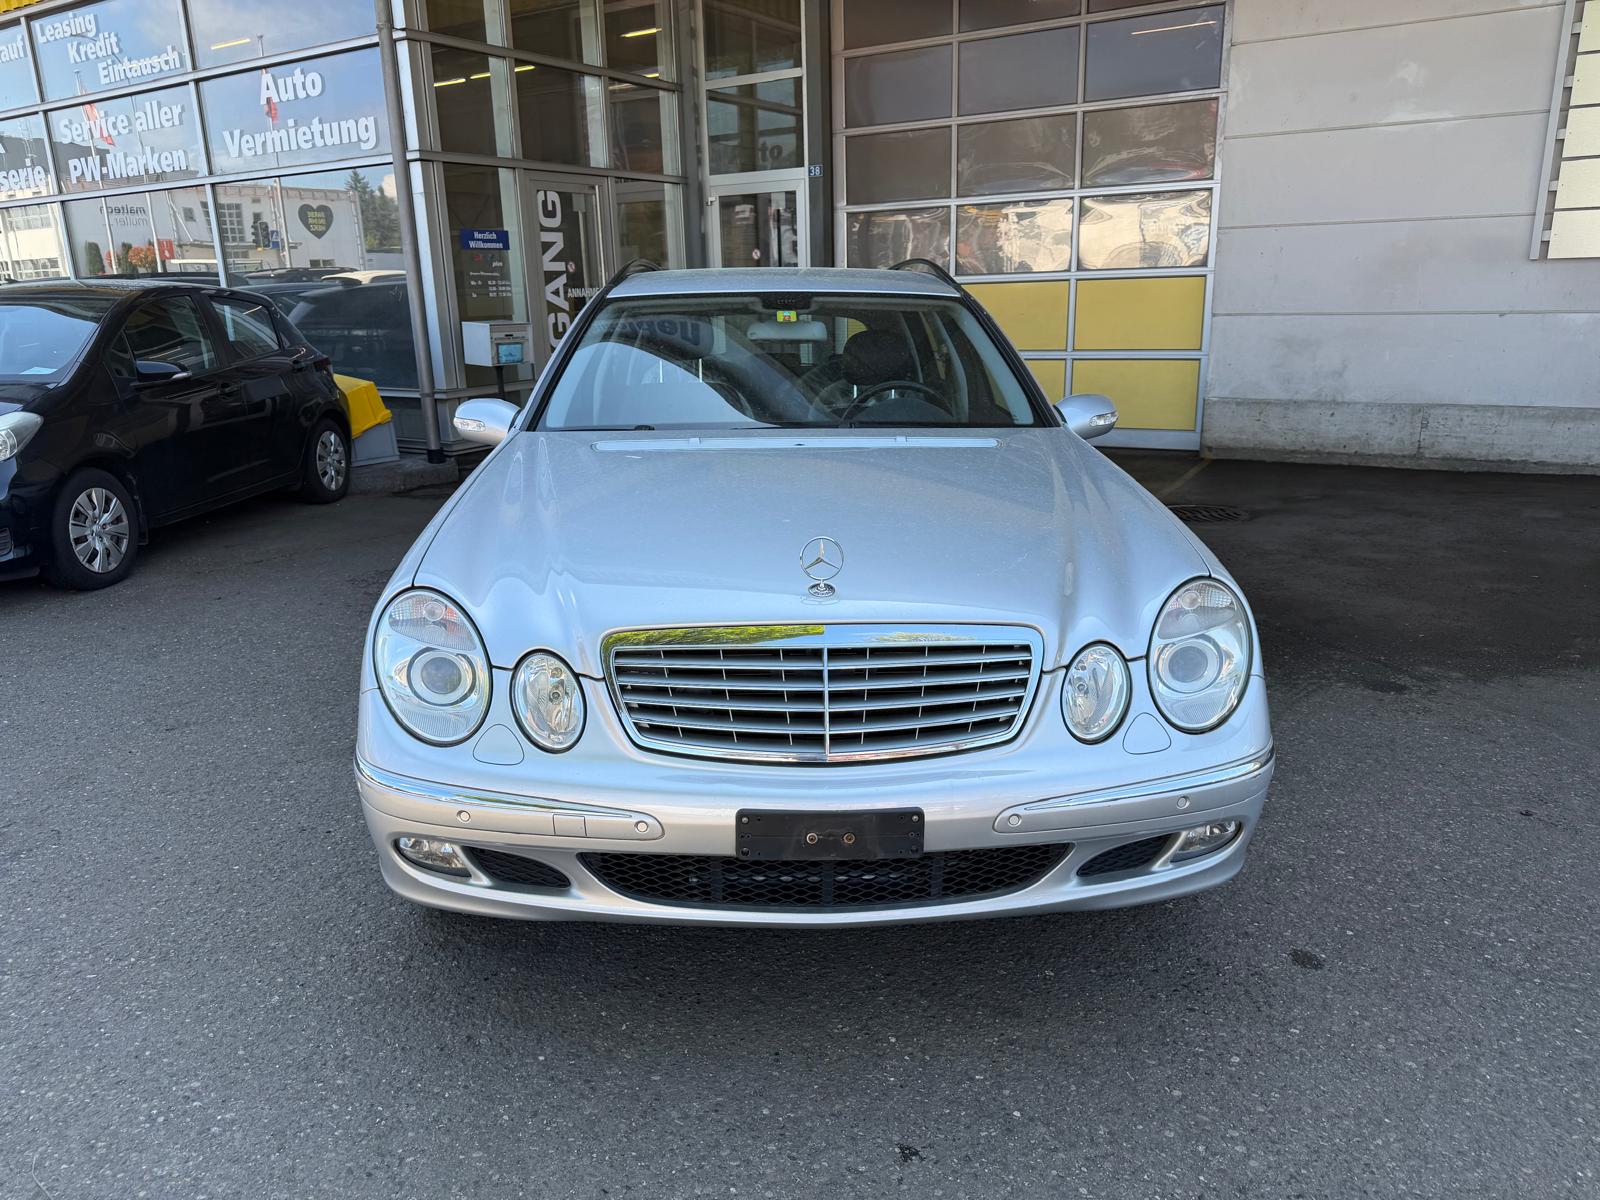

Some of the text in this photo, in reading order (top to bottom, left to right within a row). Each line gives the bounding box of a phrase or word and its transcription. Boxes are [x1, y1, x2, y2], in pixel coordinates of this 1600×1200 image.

[35, 12, 97, 43] Leasing
[67, 31, 120, 63] Kredit
[97, 45, 181, 84] Eintausch
[260, 67, 323, 105] Auto
[60, 100, 182, 144] Service aller
[222, 116, 377, 158] Vermietung
[0, 158, 47, 192] serie
[68, 146, 188, 184] PW-Marken
[809, 166, 821, 176] 38
[468, 240, 504, 249] Willkommen
[473, 231, 497, 240] Herzlich
[537, 190, 570, 349] GANG
